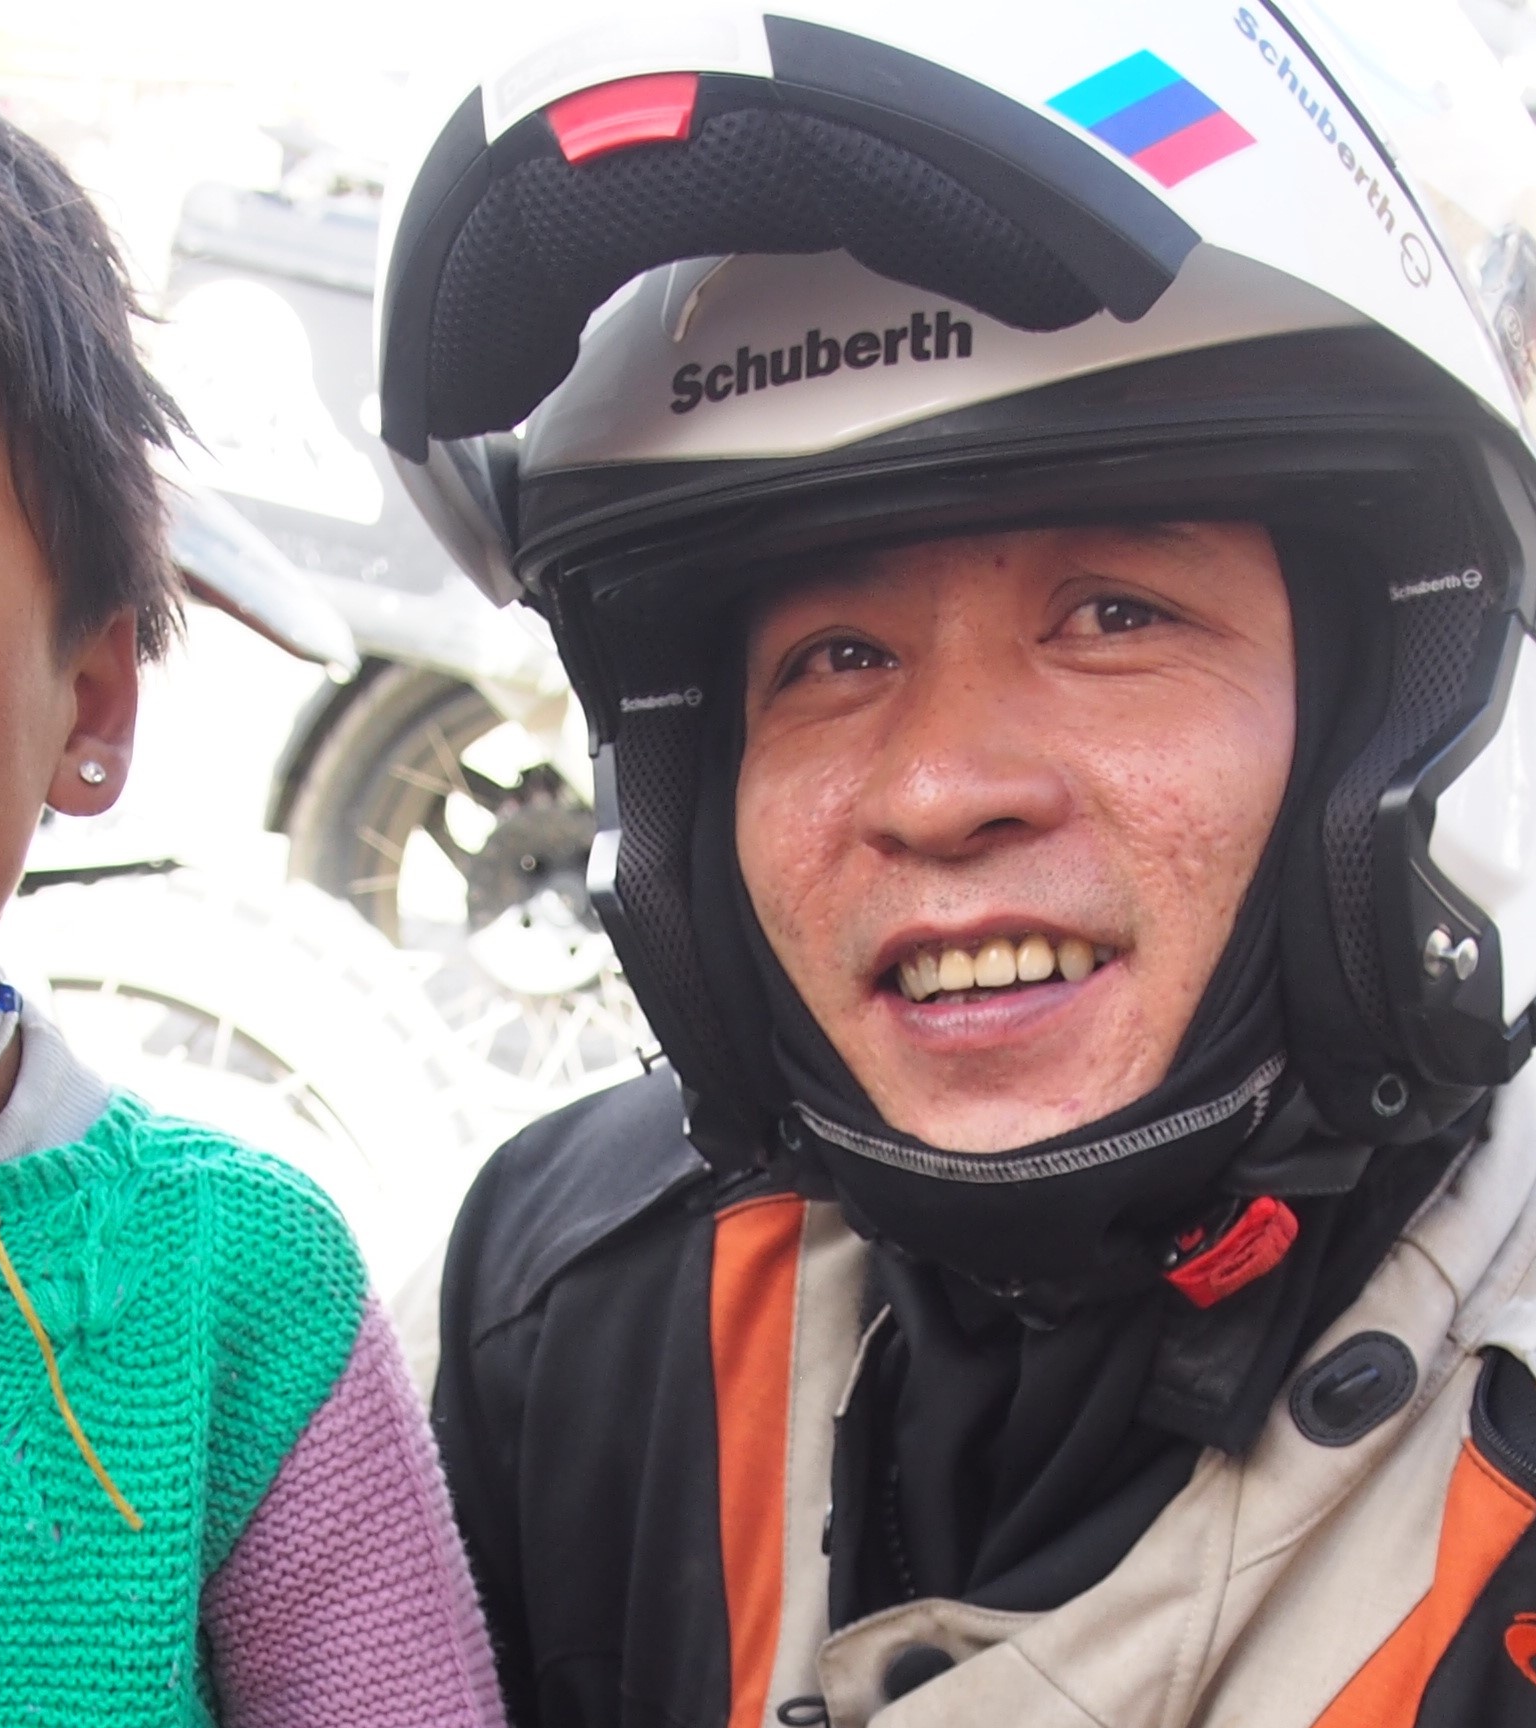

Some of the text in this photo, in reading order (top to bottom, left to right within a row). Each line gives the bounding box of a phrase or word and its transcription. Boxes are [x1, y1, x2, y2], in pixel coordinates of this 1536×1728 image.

[1232, 5, 1397, 236] Schuberth
[669, 310, 974, 415] Schuberth
[1389, 575, 1462, 602] Schuberth
